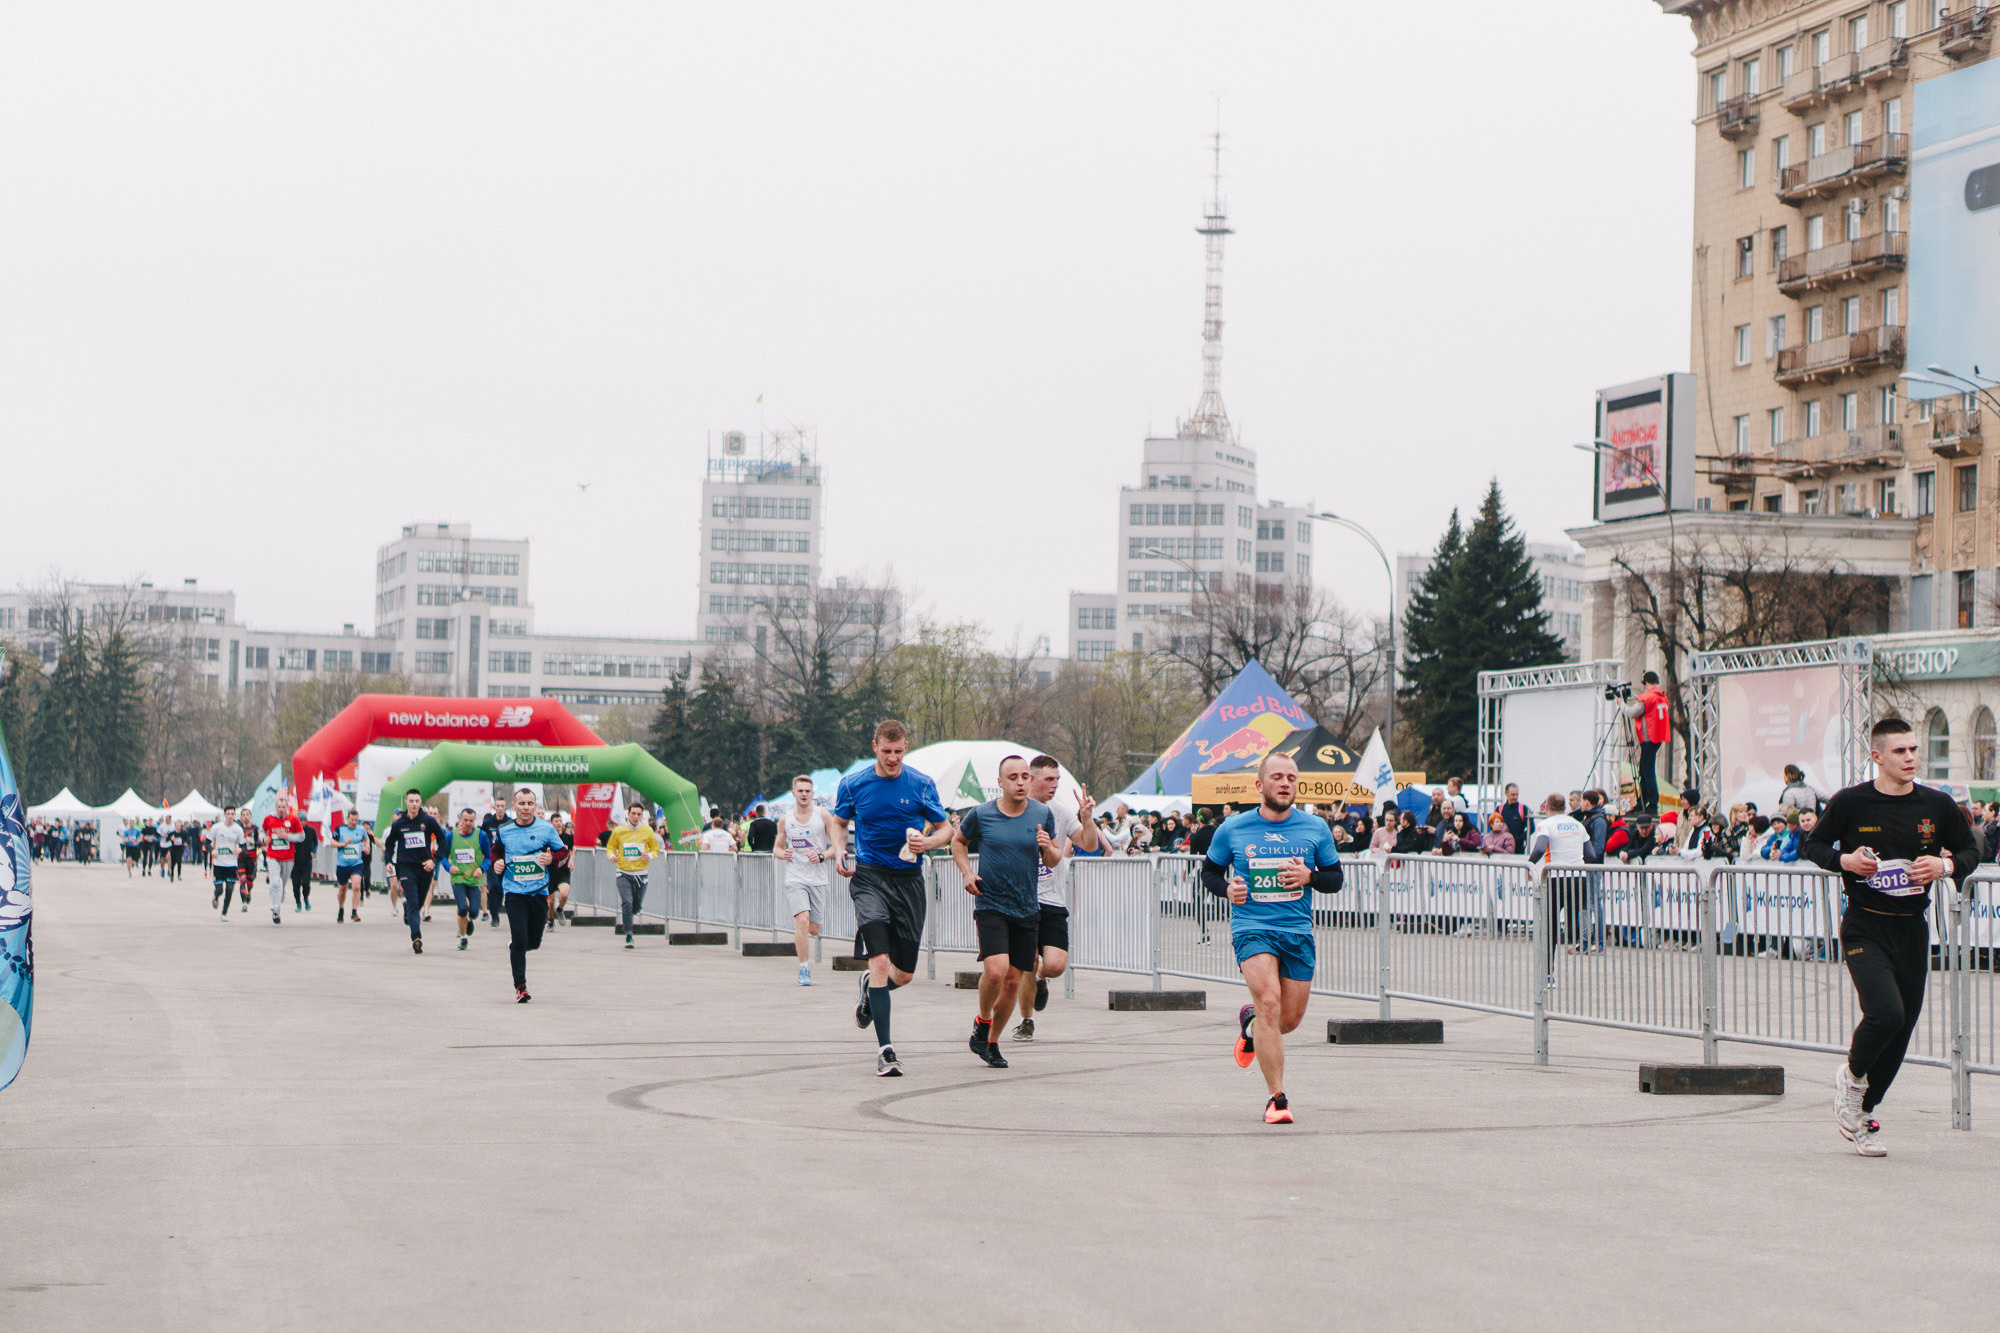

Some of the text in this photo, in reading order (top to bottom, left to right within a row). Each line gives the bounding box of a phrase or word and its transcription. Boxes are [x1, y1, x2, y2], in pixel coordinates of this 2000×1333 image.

[1219, 696, 1266, 722] Red
[1266, 696, 1306, 722] Bull
[388, 710, 423, 726] new
[424, 710, 490, 728] balance
[515, 754, 589, 763] HERBALIFE
[514, 763, 590, 773] NUTRITION
[592, 801, 613, 809] balan
[1258, 846, 1309, 855] CIKLUM
[514, 864, 536, 874] 2967
[1872, 873, 1910, 889] 5018
[1756, 890, 1815, 915] Жилстрой-
